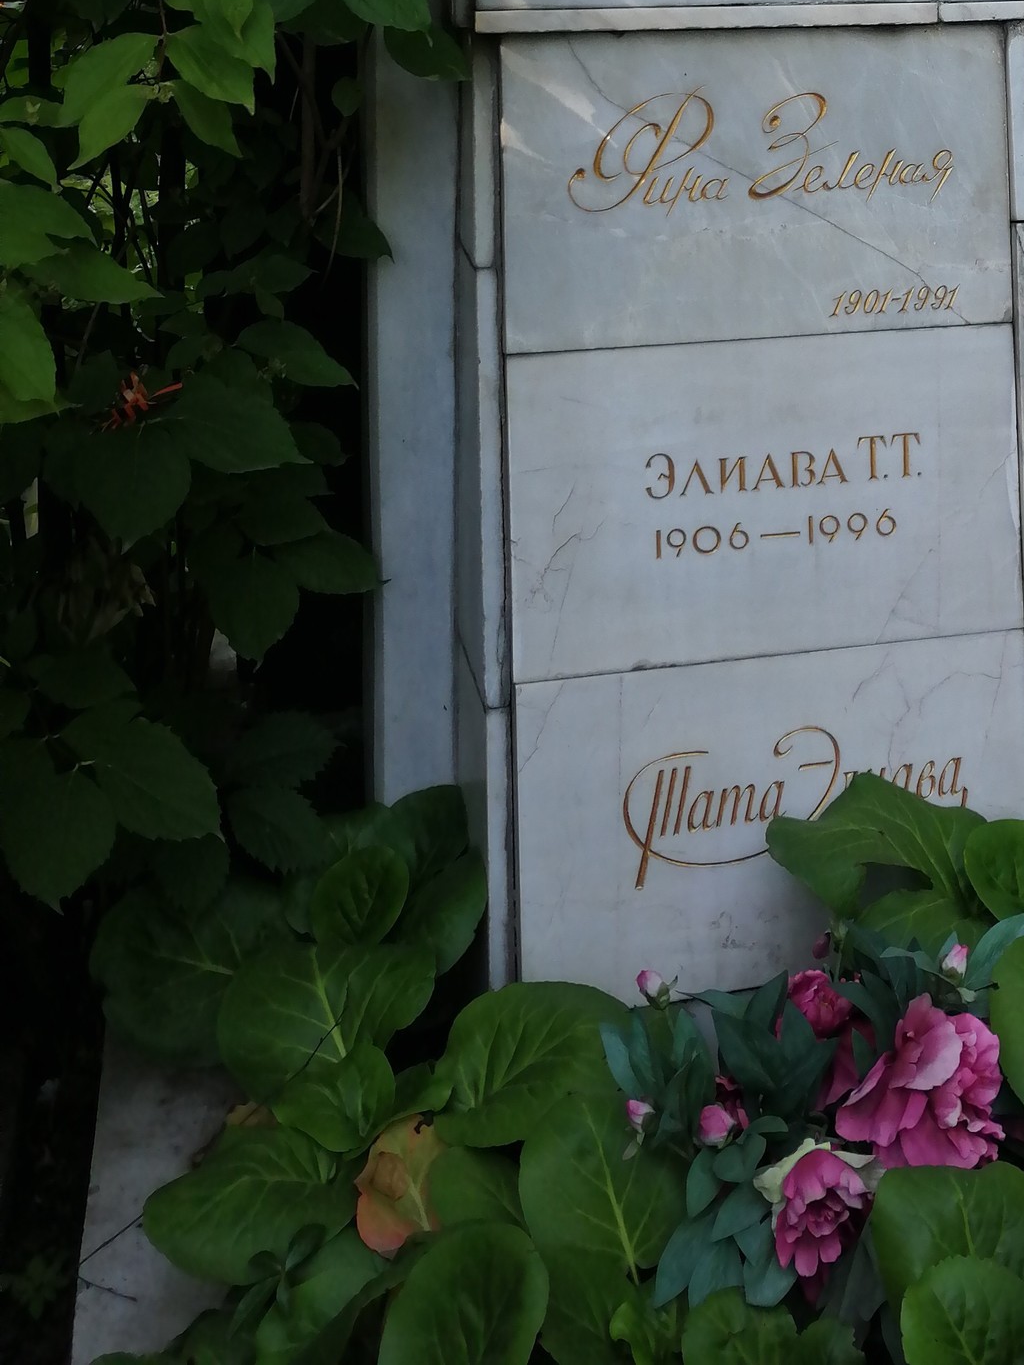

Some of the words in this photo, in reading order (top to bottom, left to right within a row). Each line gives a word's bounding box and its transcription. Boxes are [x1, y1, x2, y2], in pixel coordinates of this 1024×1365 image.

[568, 85, 729, 217] Рина
[748, 92, 953, 203] Зеленая
[829, 283, 961, 318] 1901-1991
[645, 448, 850, 500] ЭЛИАВА
[857, 432, 922, 481] Т.Т.
